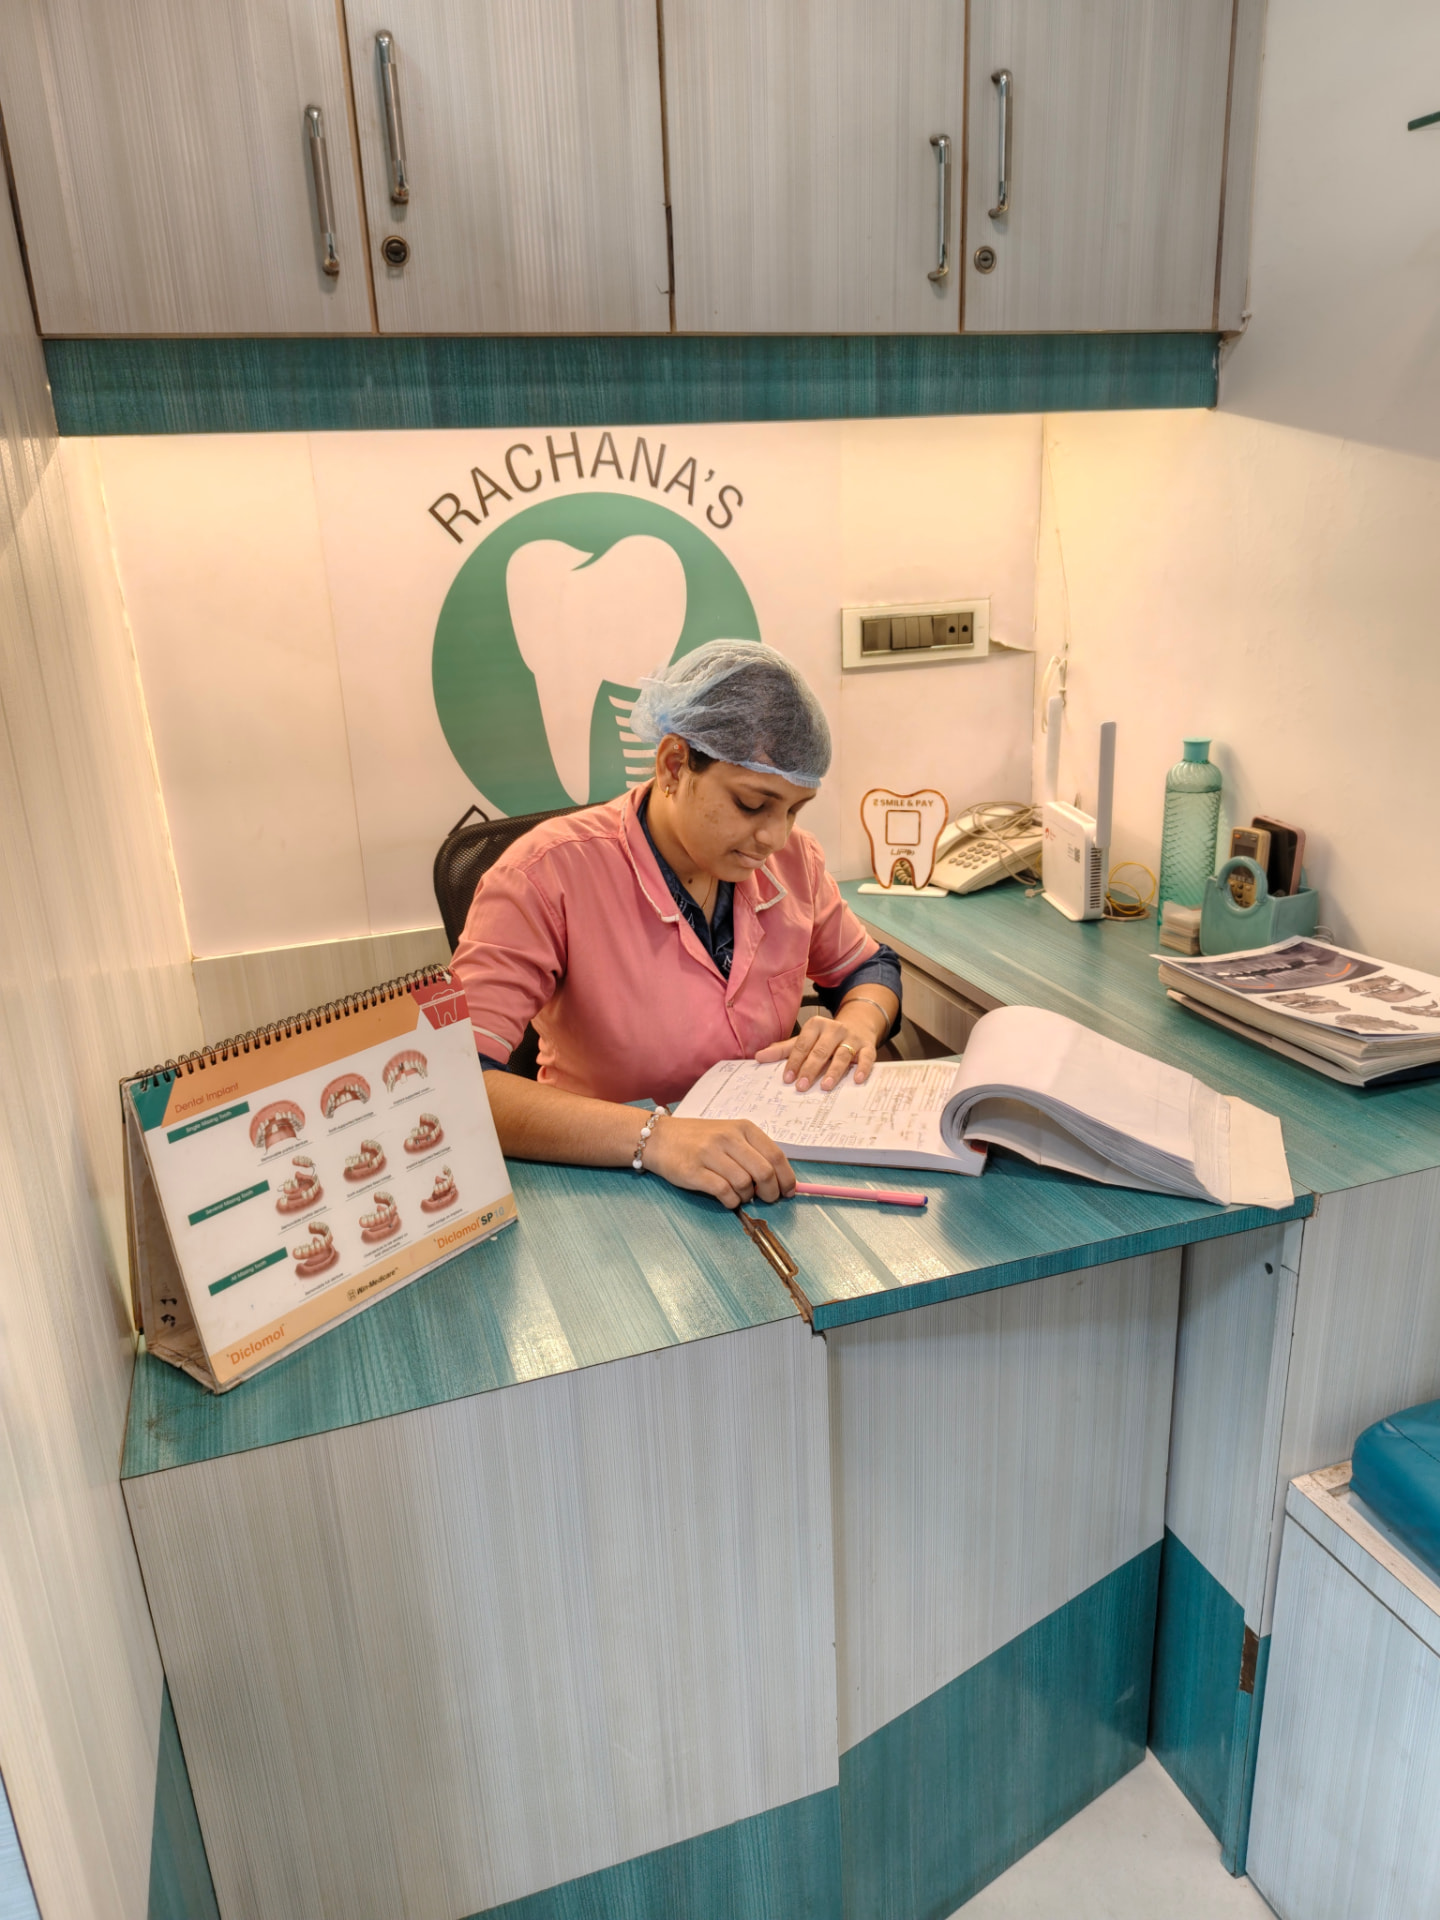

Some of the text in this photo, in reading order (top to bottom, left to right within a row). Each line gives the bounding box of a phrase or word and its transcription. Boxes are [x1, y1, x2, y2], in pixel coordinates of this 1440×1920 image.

[428, 431, 744, 544] RACHANA'S
[881, 798, 905, 807] SMILE
[915, 799, 934, 807] PAY
[174, 1082, 239, 1114] Dental Implant
[436, 1218, 480, 1249] Diclomol
[480, 1212, 493, 1226] SP
[229, 1325, 286, 1365] Diclomol
